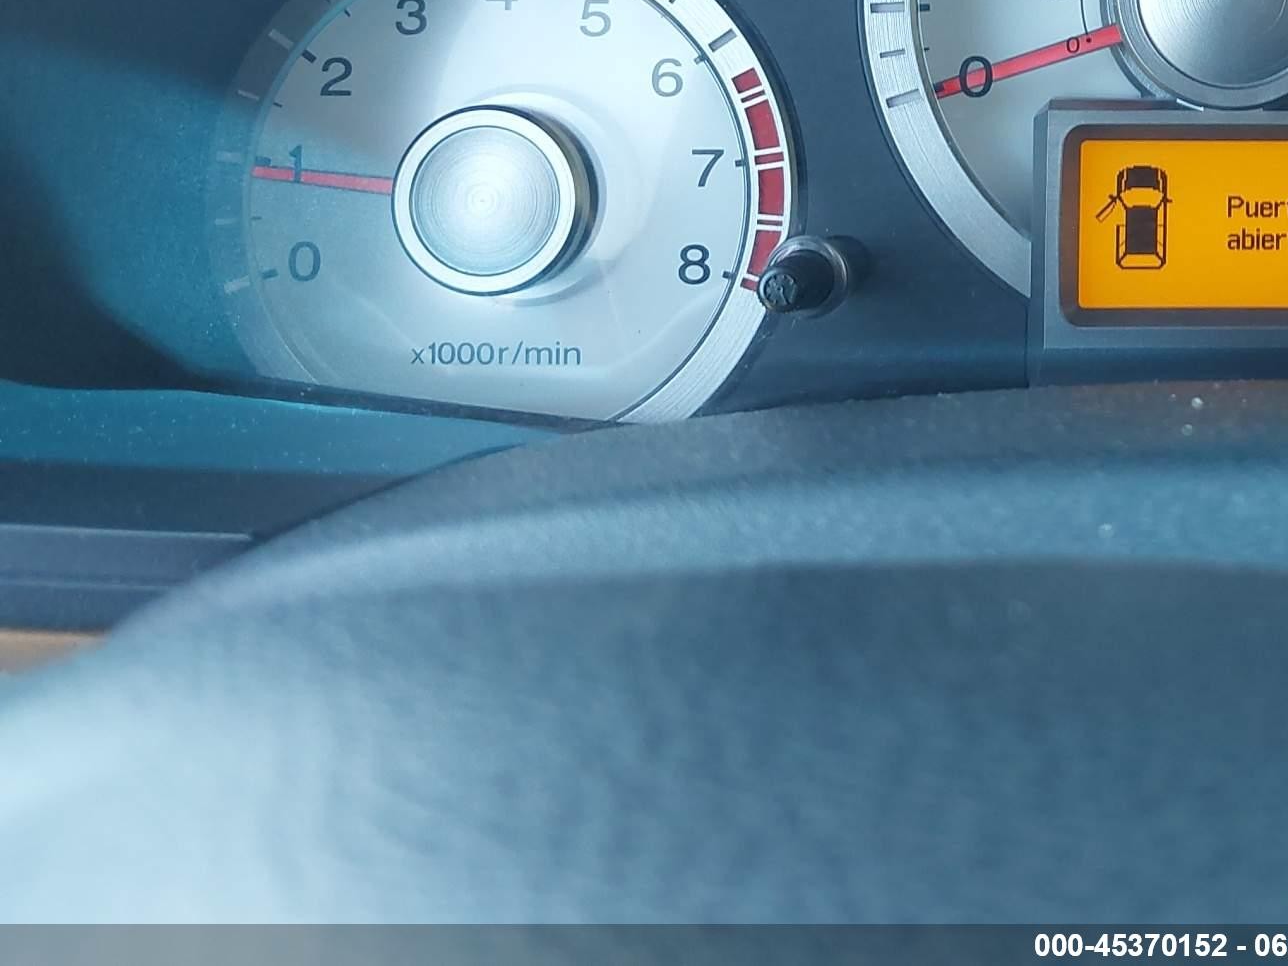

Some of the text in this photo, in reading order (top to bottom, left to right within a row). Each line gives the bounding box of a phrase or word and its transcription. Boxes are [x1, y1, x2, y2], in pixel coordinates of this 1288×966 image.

[1065, 36, 1081, 55] 0
[319, 56, 353, 96] 2
[651, 58, 684, 98] 6
[958, 55, 994, 99] 0
[288, 144, 302, 183] 1
[691, 148, 725, 188] 7
[288, 240, 321, 282] 0
[677, 244, 711, 285] 8
